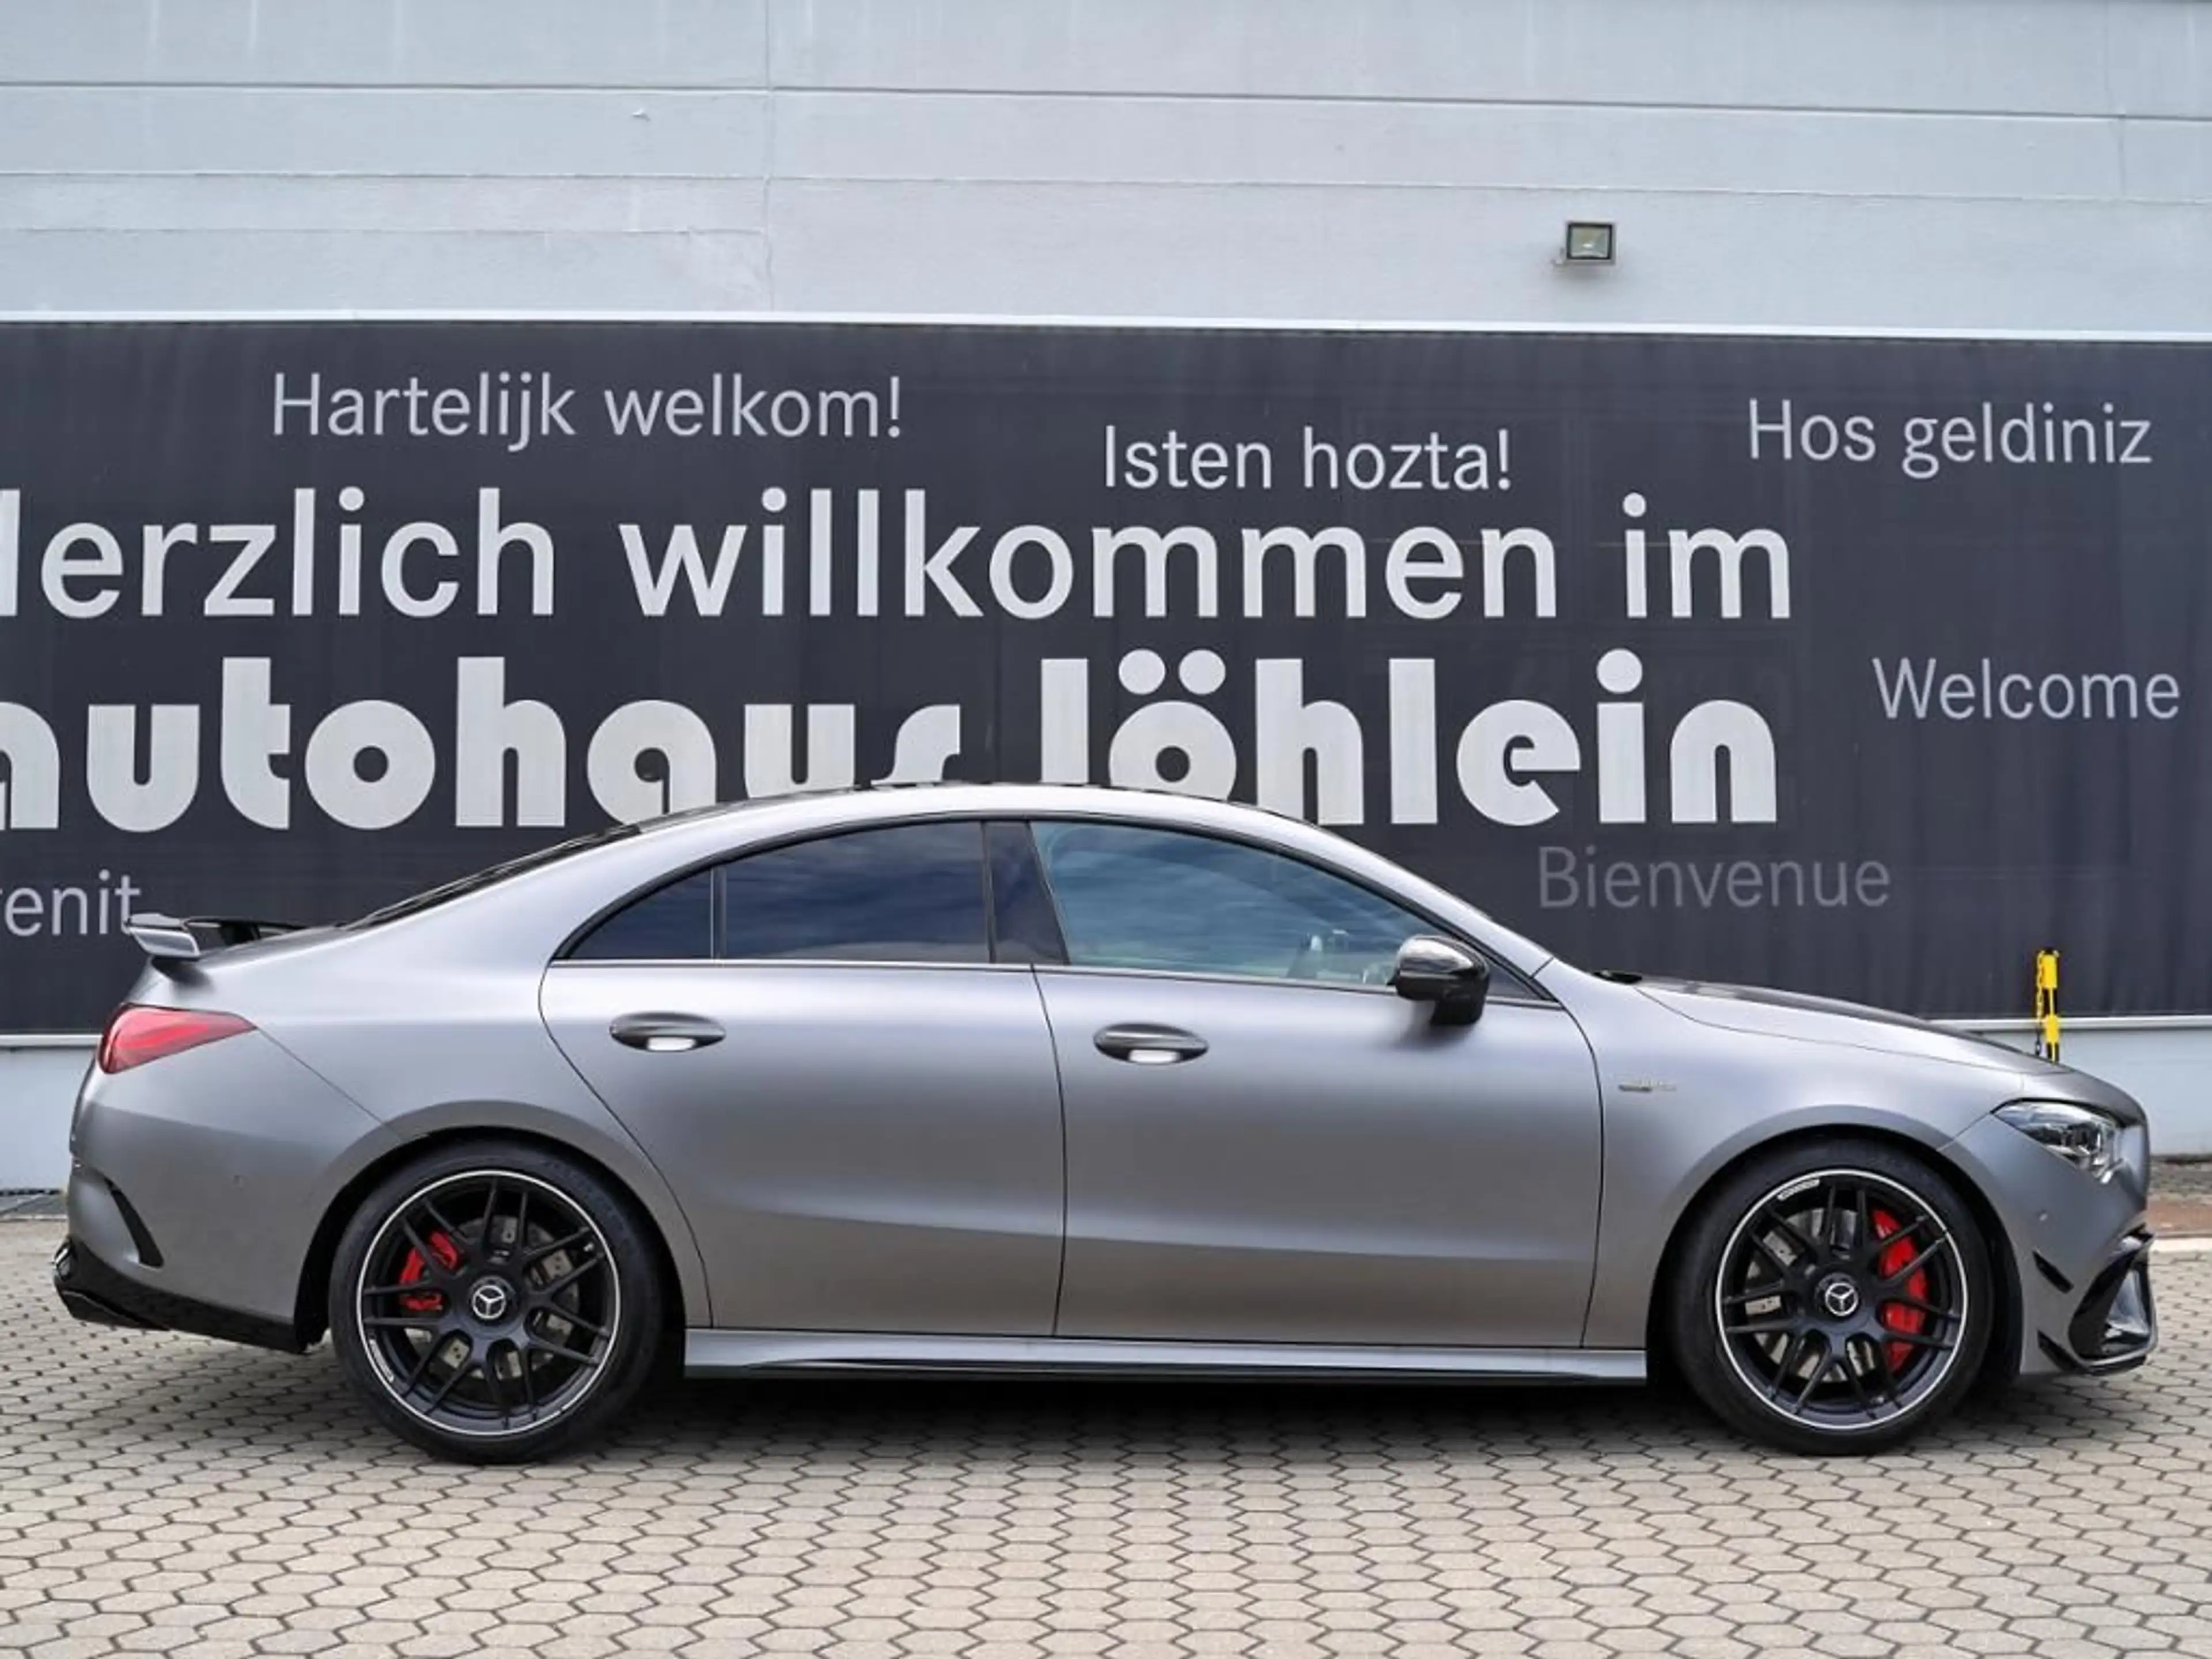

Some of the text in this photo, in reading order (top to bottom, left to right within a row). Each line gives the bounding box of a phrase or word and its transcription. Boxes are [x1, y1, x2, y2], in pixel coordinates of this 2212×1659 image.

[274, 372, 900, 452] Hartelijk welkom!
[1749, 398, 2153, 479] Hos geldiniz
[1105, 425, 1510, 491] Isten hozta!
[618, 486, 1556, 620] willkommen
[1622, 492, 1791, 619] im
[1872, 657, 2180, 719] Welcome
[1040, 648, 1777, 826] löhlein
[0, 869, 141, 937] enit
[1539, 845, 1891, 908] Bienvenue
